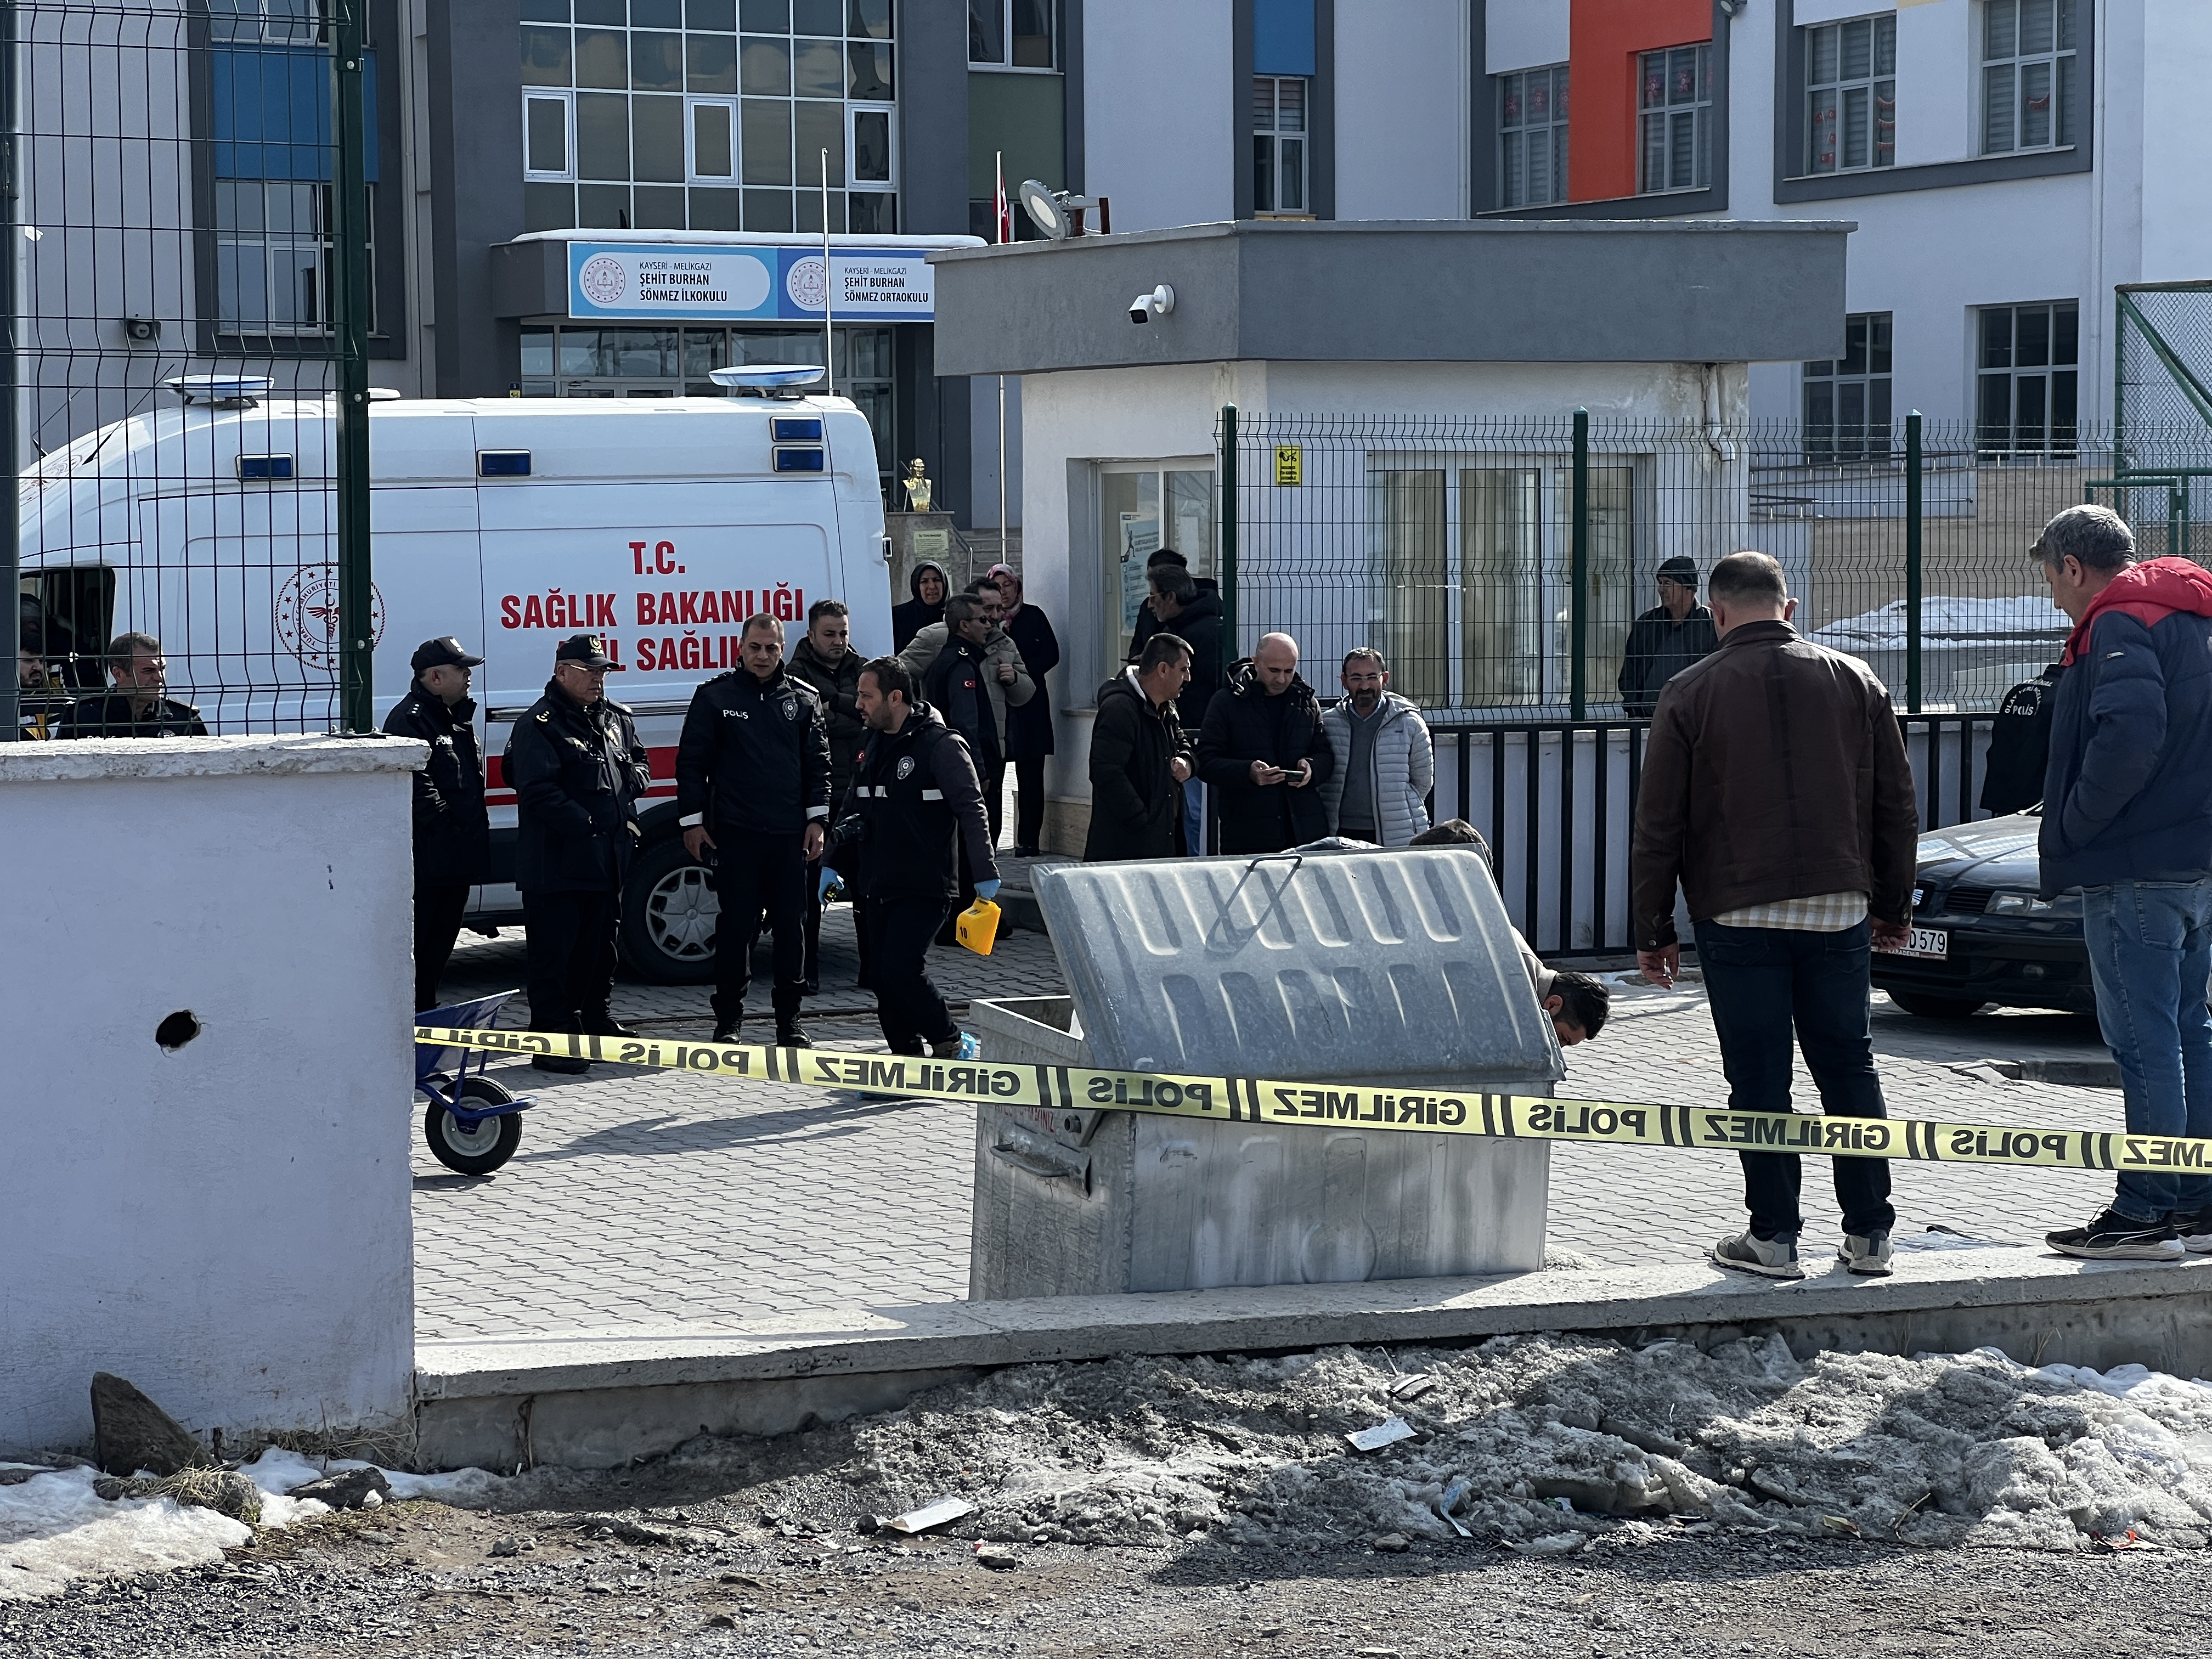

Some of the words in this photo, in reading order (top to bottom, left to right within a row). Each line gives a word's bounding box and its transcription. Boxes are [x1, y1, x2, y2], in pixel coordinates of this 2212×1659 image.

[640, 271, 667, 287] ŞEHİT
[669, 274, 709, 285] BURHAN
[844, 275, 868, 289] ŞEHİT
[870, 278, 905, 287] BURHAN
[640, 287, 679, 301] SÖNMEZ
[681, 288, 727, 302] İLKOKULU
[844, 290, 878, 302] SÖNMEZ
[880, 292, 928, 302] ORTAOKULU
[629, 540, 686, 575] T.C.
[501, 588, 617, 629] SAĞLIK
[636, 582, 804, 625] BAKANLIĞI
[960, 926, 968, 939] 10
[1920, 931, 1945, 952] 579
